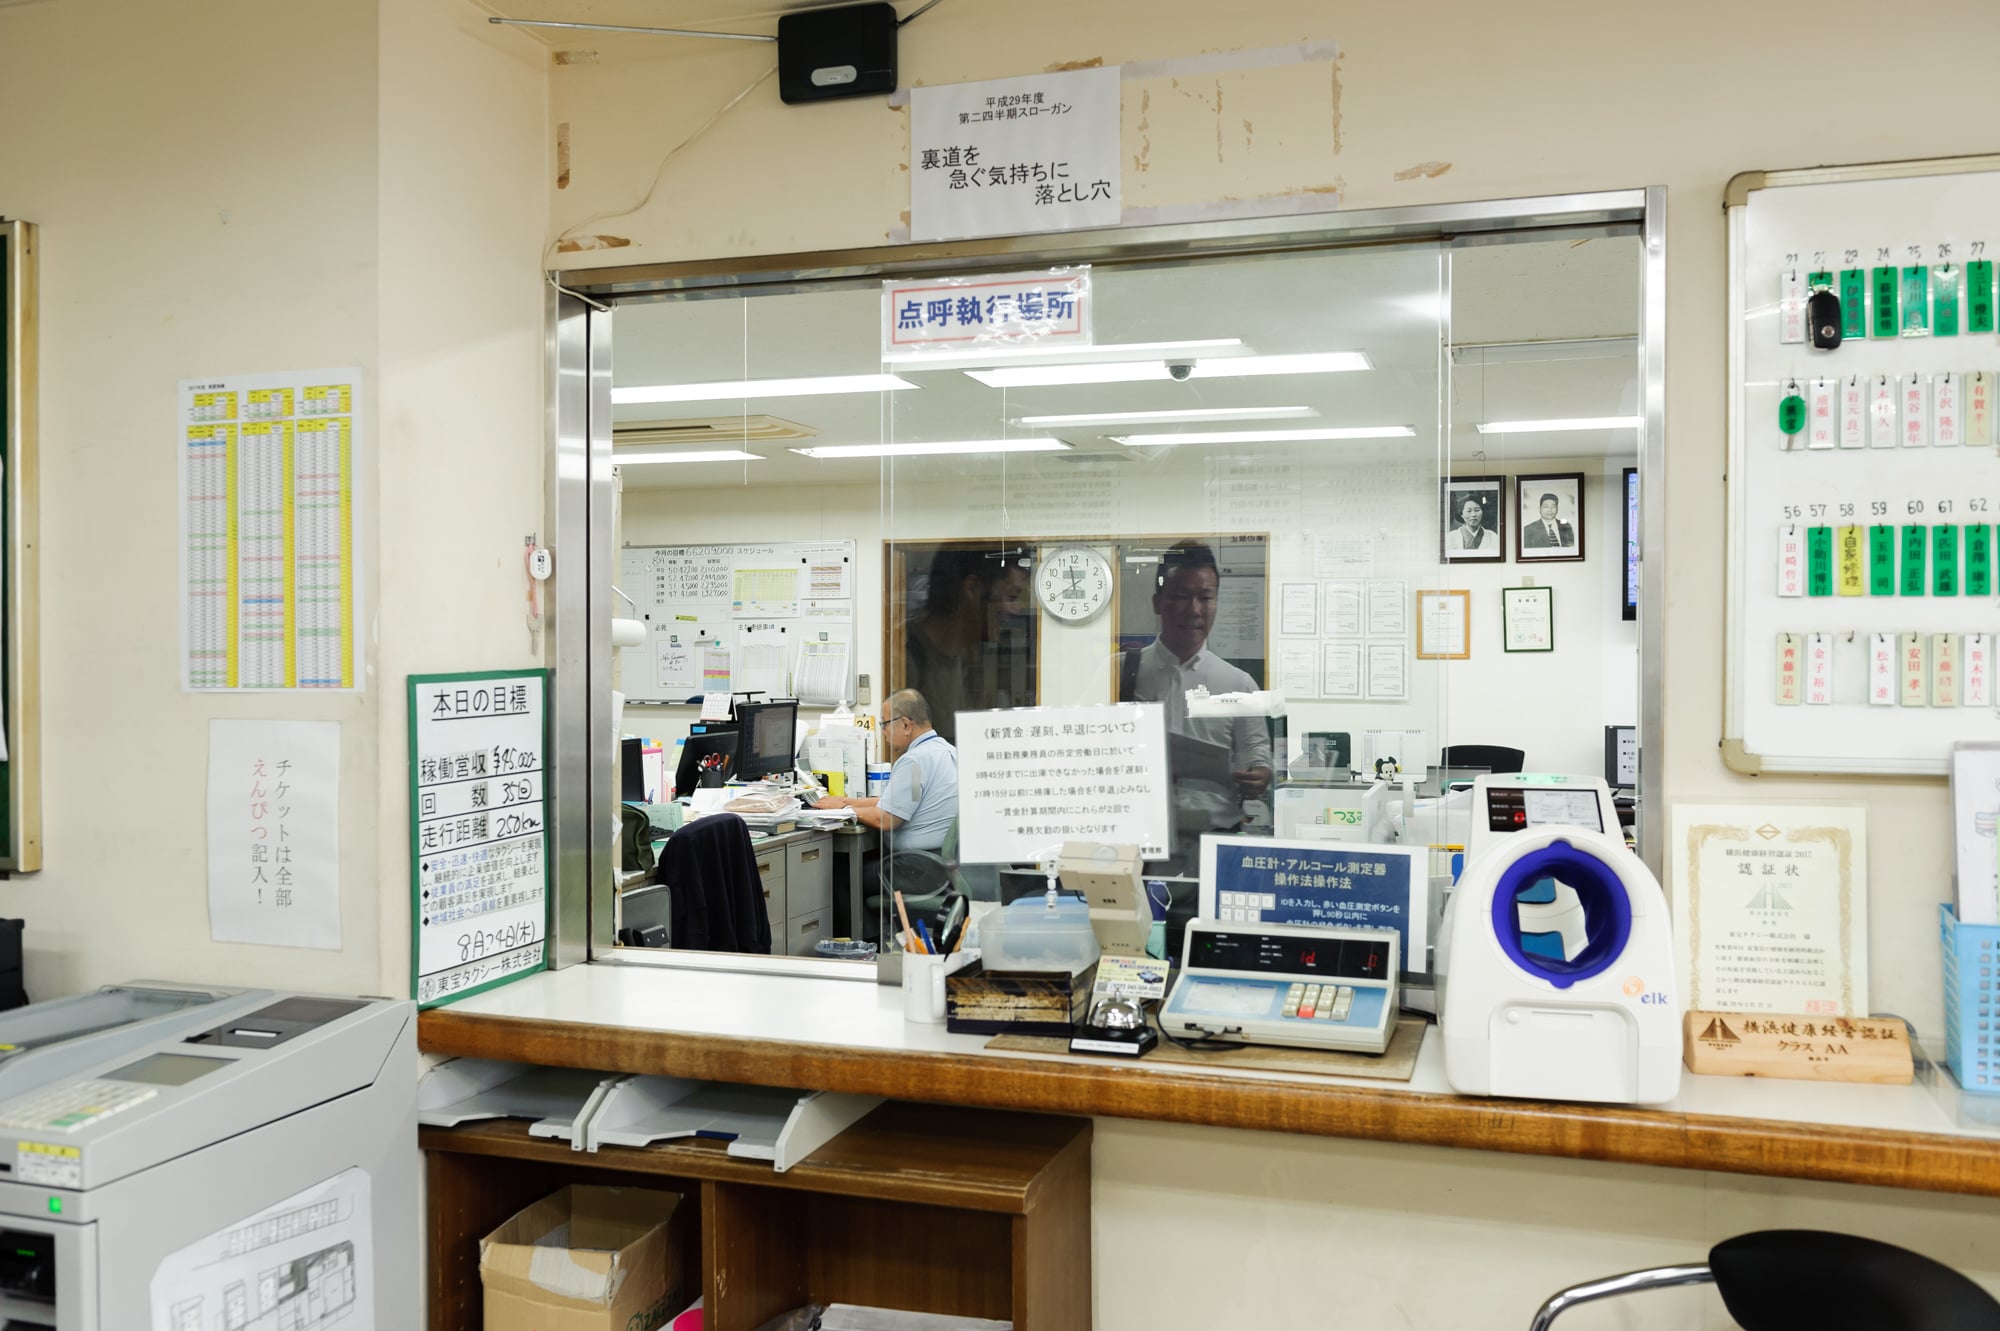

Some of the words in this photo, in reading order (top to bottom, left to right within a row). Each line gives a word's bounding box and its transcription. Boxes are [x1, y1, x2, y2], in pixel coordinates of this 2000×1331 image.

[985, 92, 1044, 108] 平成29年度
[959, 104, 1072, 124] 第二四半期スローガン
[921, 145, 980, 170] 裏道を
[949, 161, 1070, 190] 急ぐ気持ちに
[1035, 179, 1112, 206] 落とし穴
[897, 291, 1076, 330] 点呼執行場所
[1810, 504, 1827, 517] 57
[1839, 503, 1854, 517] 58
[1871, 502, 1887, 516] 59
[1907, 500, 1924, 515] 60
[1938, 500, 1953, 514] 61
[1969, 498, 1988, 512] 62
[1784, 506, 1801, 519] 56
[1058, 558, 1066, 567] 11
[1070, 555, 1079, 564] 12
[1085, 558, 1089, 567] 1
[1049, 568, 1058, 577] 10
[1093, 567, 1099, 576] 2
[1045, 581, 1052, 589] 9
[1097, 580, 1103, 589] 3
[1049, 593, 1056, 601] 8
[1092, 594, 1098, 602] 4
[1059, 603, 1065, 611] 7
[1071, 606, 1077, 615] 6
[1083, 603, 1089, 611] 5
[433, 685, 527, 717] 本日の目標
[857, 720, 870, 730] 24
[420, 752, 487, 782] 稼働営収
[251, 759, 268, 904] えんぴつ記入！
[275, 759, 292, 908] チケットは全部
[421, 816, 488, 849] 走行距離
[1241, 855, 1387, 877] 血圧計・アルコール測定器
[1737, 862, 1800, 877] 認証状
[1274, 872, 1352, 890] 操作法操作法
[437, 945, 542, 994] 東宝タクシー株式会社
[1641, 992, 1668, 1005] elk
[1743, 1019, 1898, 1041] 横浜健康経営認証
[1778, 1040, 1814, 1053] クラス
